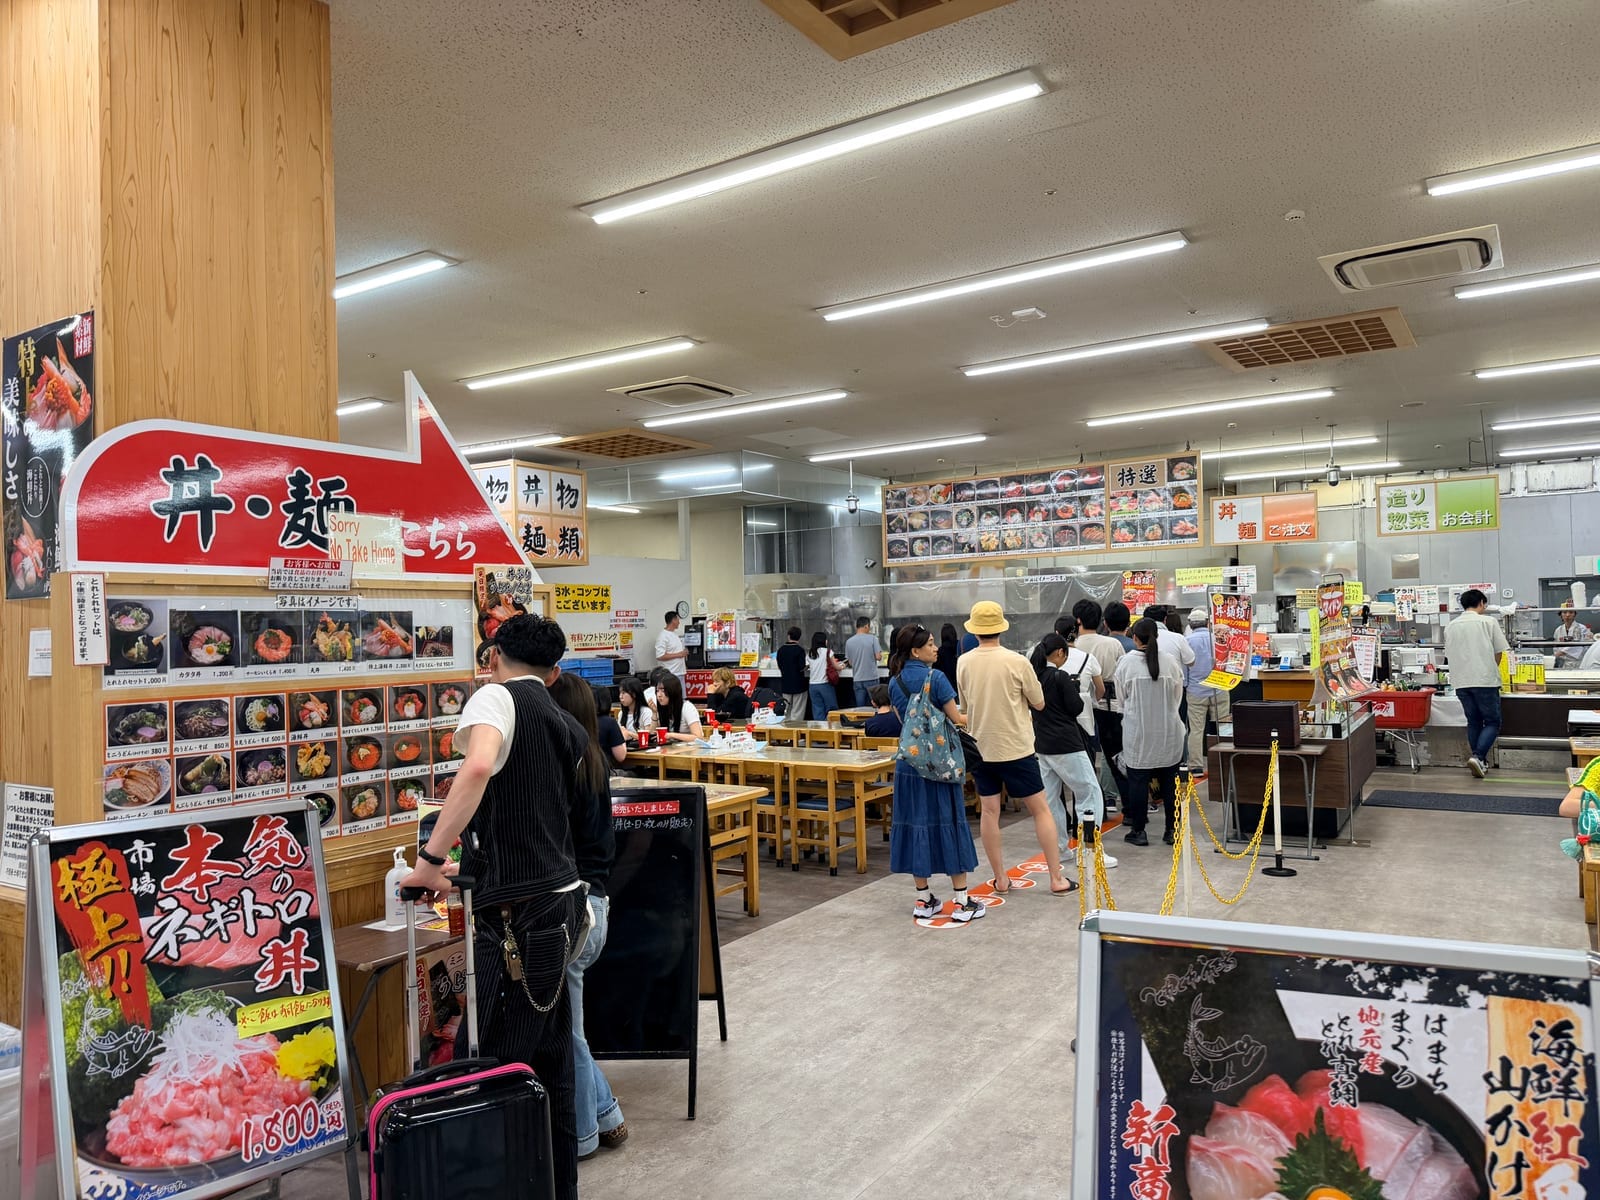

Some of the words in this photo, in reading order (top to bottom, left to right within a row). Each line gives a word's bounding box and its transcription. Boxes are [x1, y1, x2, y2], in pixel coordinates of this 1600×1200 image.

[1117, 464, 1158, 487] 特選
[1386, 488, 1426, 509] 造り
[1218, 502, 1237, 520] 丼
[1387, 511, 1430, 531] 惣菜
[1442, 510, 1493, 527] お会計
[329, 514, 361, 535] Sorry
[1238, 521, 1257, 541] 麺
[1268, 522, 1312, 537] ご注文
[330, 540, 343, 561] No
[345, 540, 369, 564] Take
[371, 541, 396, 564] Home
[278, 596, 357, 608] 写真はイメージです。
[123, 838, 156, 897] 市場
[1357, 1004, 1385, 1076] 地元産
[1391, 1008, 1418, 1089] まぐろ
[1423, 1013, 1449, 1094] はまち
